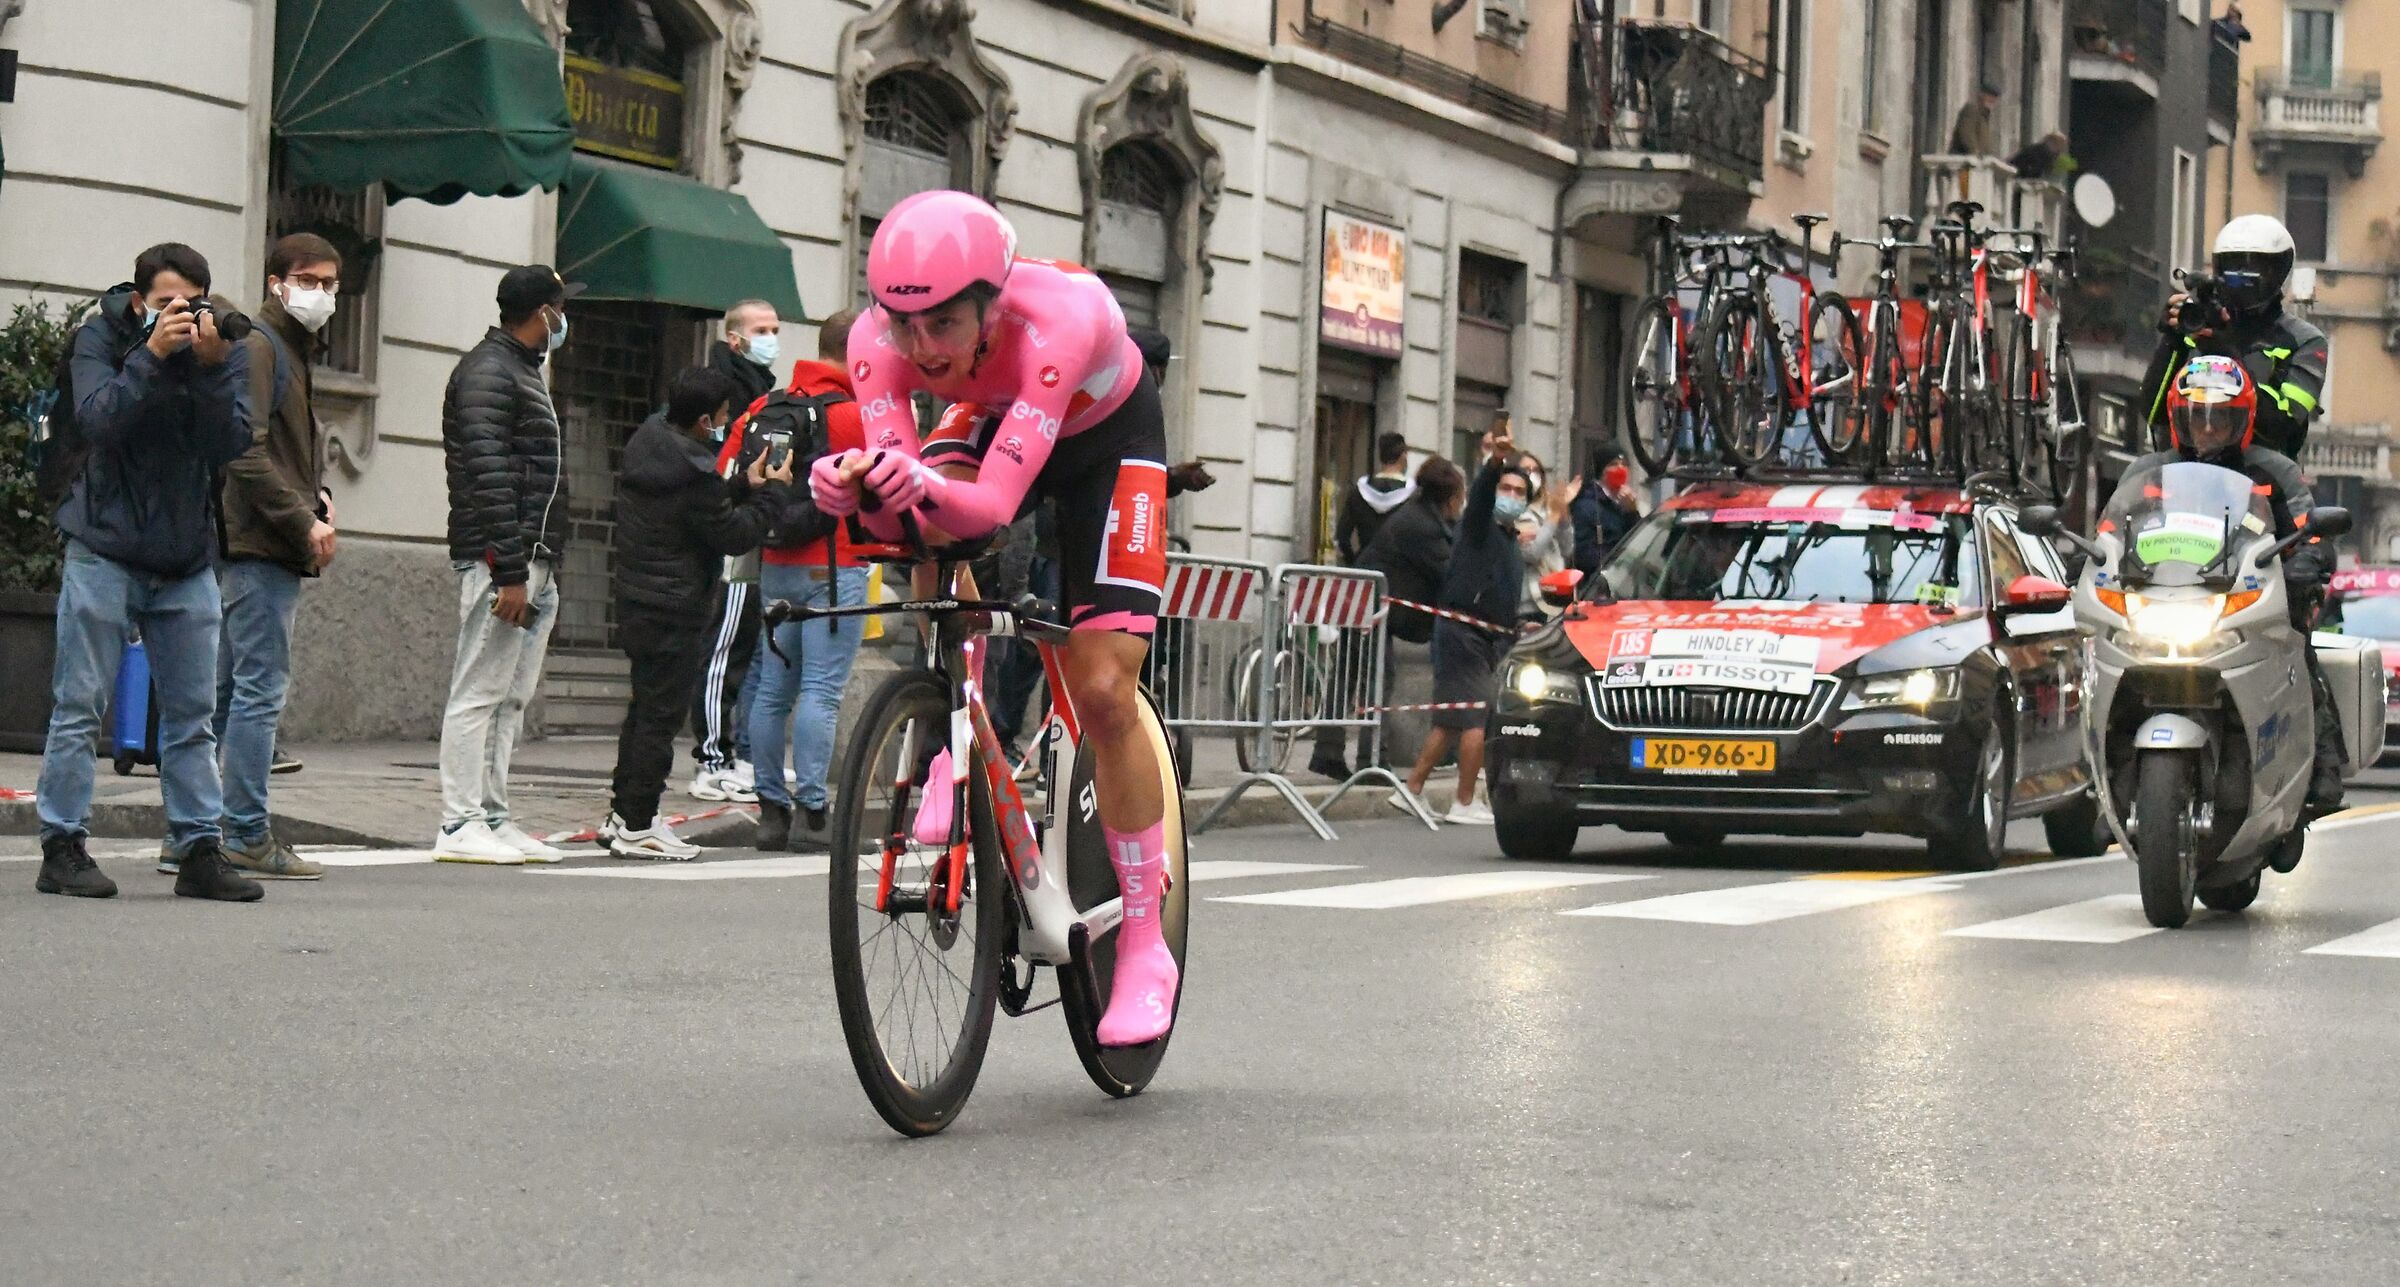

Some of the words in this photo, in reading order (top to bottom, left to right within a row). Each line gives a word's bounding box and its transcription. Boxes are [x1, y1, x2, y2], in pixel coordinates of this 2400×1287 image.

[885, 285, 932, 295] LAZER
[1126, 492, 1150, 554] Sunweb
[2153, 535, 2216, 551] PRODUCTION
[2332, 571, 2376, 590] enel
[1619, 632, 1646, 655] 185
[1687, 635, 1754, 653] HINDLEY
[1757, 639, 1780, 655] Jai
[1698, 664, 1796, 685] TISSOT
[1895, 733, 1943, 744] RENSON
[1633, 756, 1642, 764] NL
[1654, 743, 1767, 766] XD-966-J
[1127, 875, 1143, 894] S
[1145, 993, 1163, 1014] S
